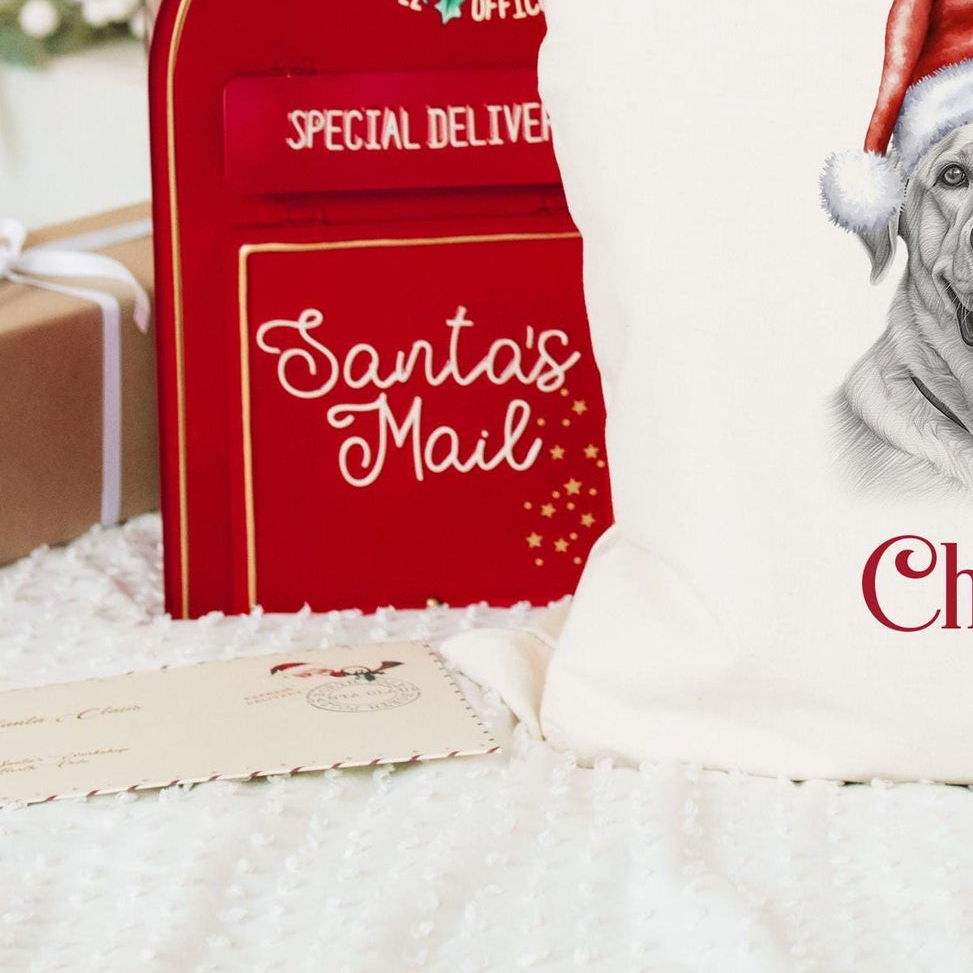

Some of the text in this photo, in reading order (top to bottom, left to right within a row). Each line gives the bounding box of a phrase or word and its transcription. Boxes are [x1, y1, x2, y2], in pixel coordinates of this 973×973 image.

[286, 105, 421, 151] SPECIAL
[256, 305, 582, 399] Santa's
[326, 392, 543, 487] Mail
